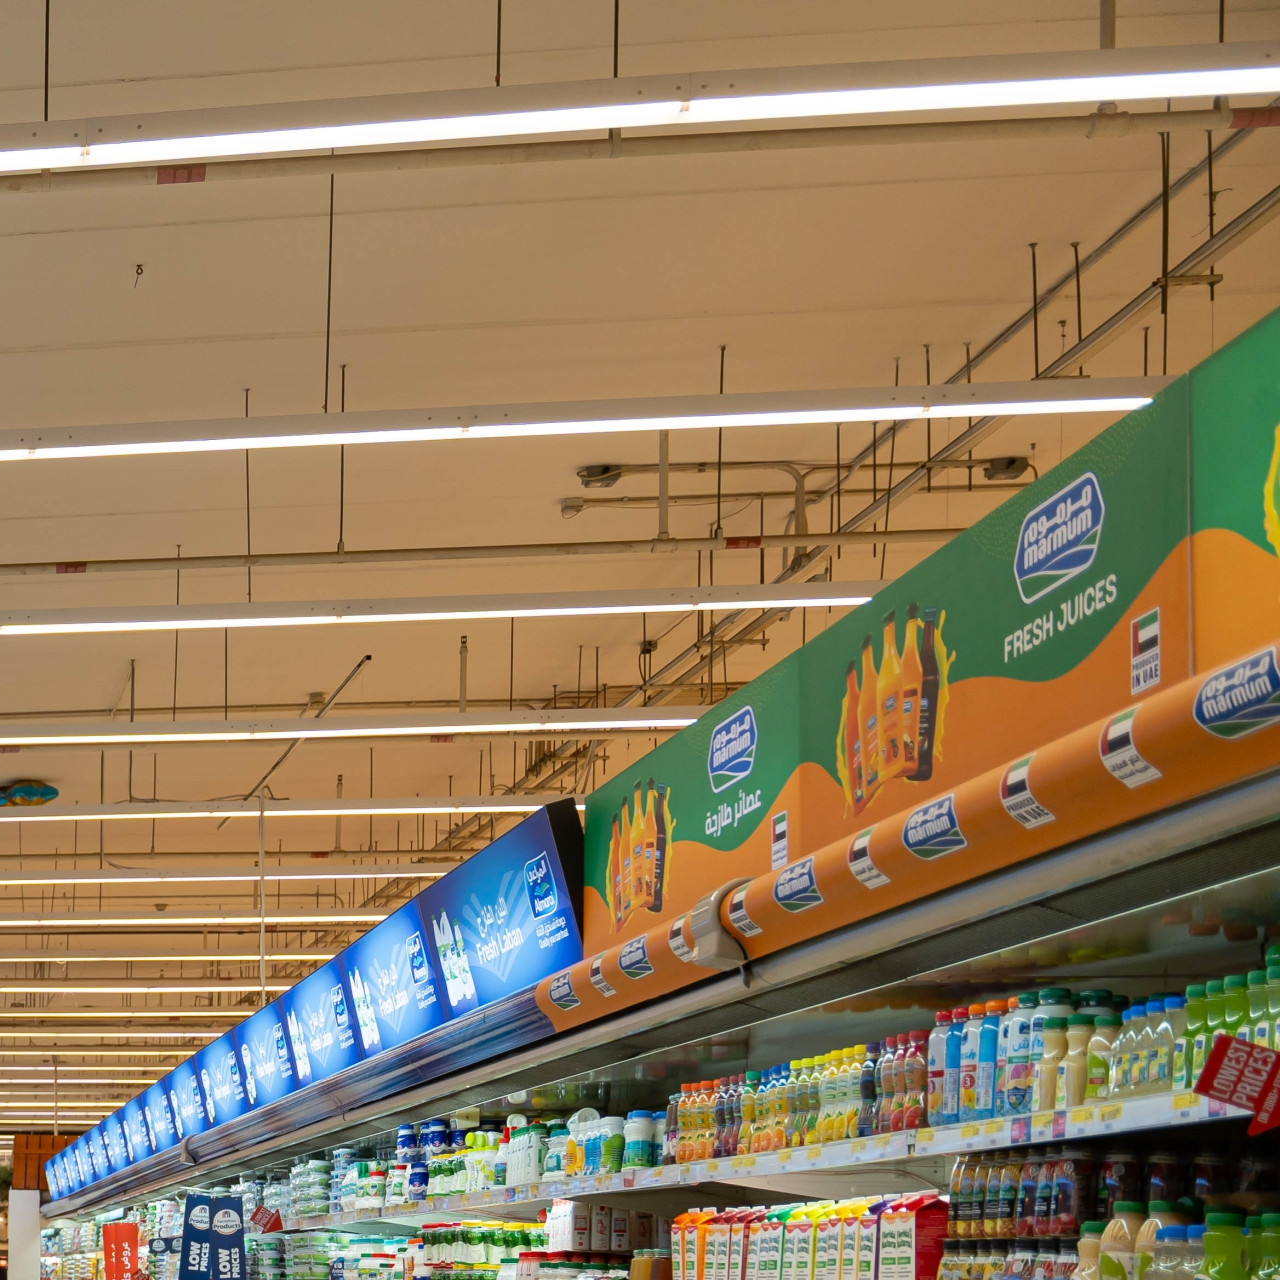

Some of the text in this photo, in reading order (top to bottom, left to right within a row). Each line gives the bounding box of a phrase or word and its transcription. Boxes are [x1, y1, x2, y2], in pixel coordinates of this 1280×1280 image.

[1024, 508, 1092, 570] marmum
[1004, 574, 1118, 664] FRESH JUICES
[1132, 652, 1159, 673] PRODUCED
[1132, 664, 1159, 689] IN UAE
[1202, 675, 1272, 719] marmum
[713, 731, 751, 767] marmum
[705, 789, 762, 837] عصائر طازجة
[908, 815, 952, 843] marmum
[777, 874, 810, 898] marmum
[534, 892, 555, 914] Almarai
[476, 928, 524, 964] Fresh Laban
[1210, 1040, 1250, 1099] LOWEST
[1232, 1048, 1276, 1107] PRICES
[189, 1242, 201, 1271] LOW
[200, 1242, 210, 1272] PRICES
[219, 1249, 230, 1279] LOW
[232, 1248, 240, 1278] PRICES
